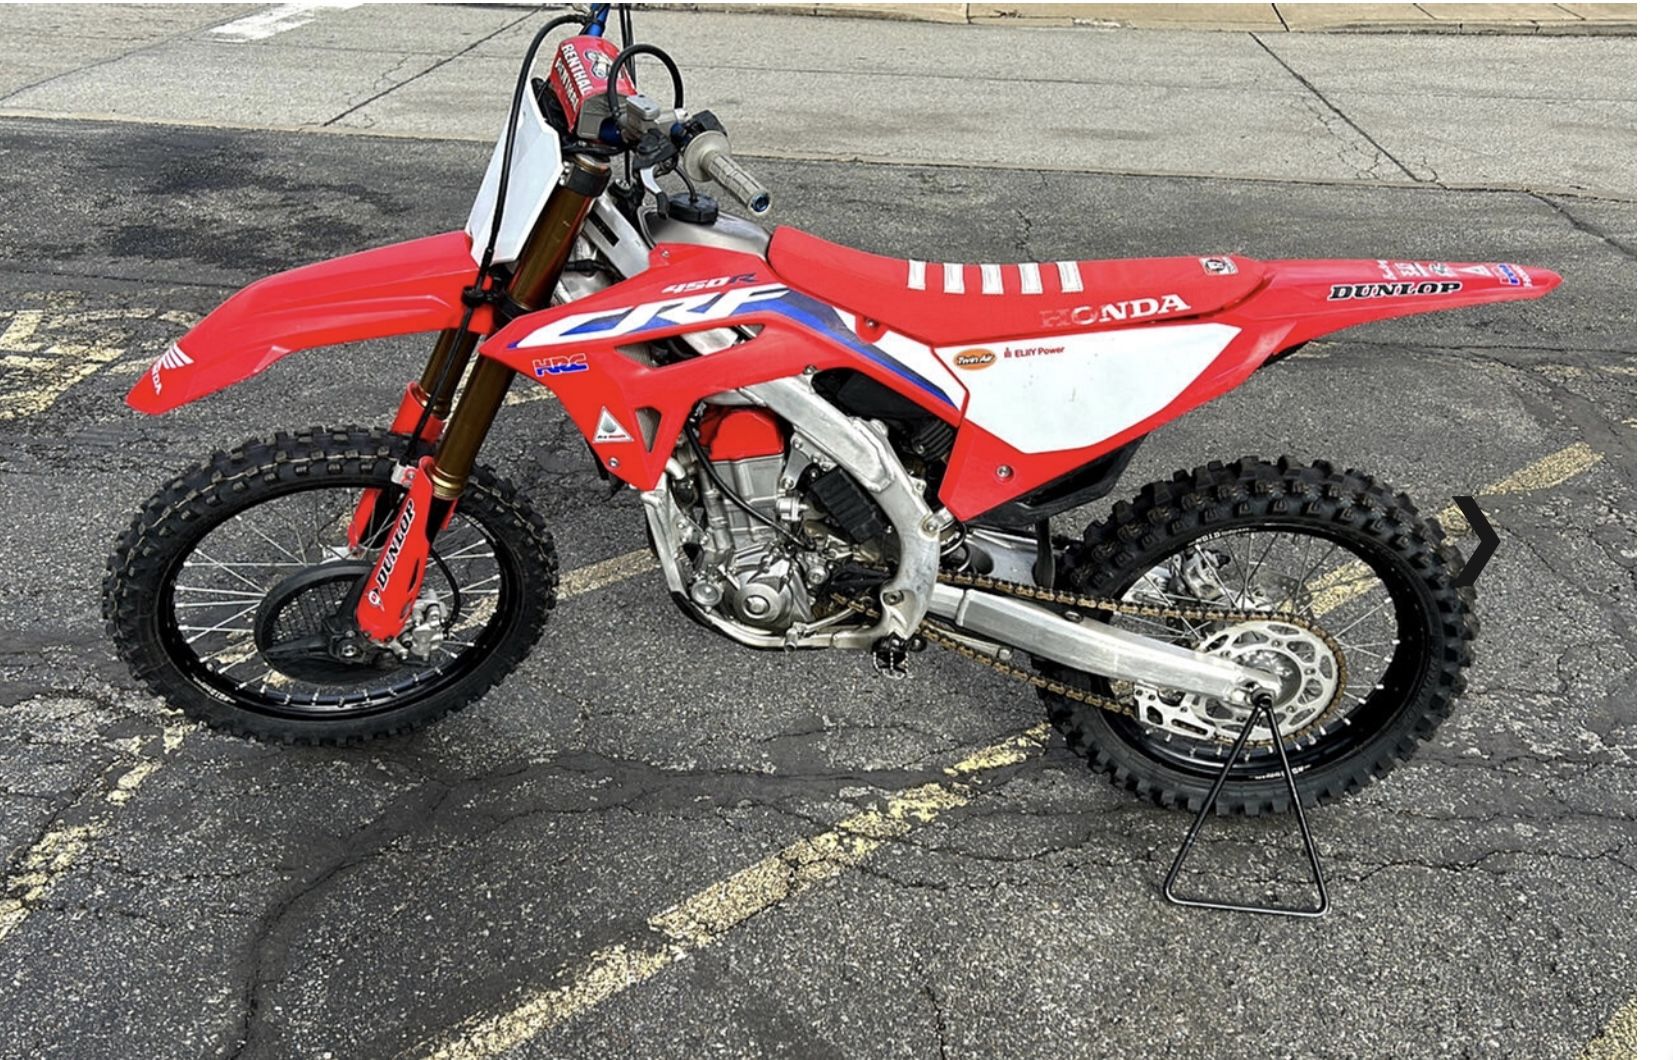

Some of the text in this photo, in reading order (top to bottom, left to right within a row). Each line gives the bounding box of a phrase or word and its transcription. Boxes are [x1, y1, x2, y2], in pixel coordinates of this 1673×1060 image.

[561, 43, 594, 97] RENTHAL
[662, 272, 759, 295] 450R
[1327, 280, 1462, 301] DUNLOP
[512, 283, 790, 349] CRF
[1039, 294, 1191, 328] HONDA
[532, 353, 590, 377] HRC
[1037, 346, 1066, 356] Power
[376, 498, 416, 591] DUNLOP
